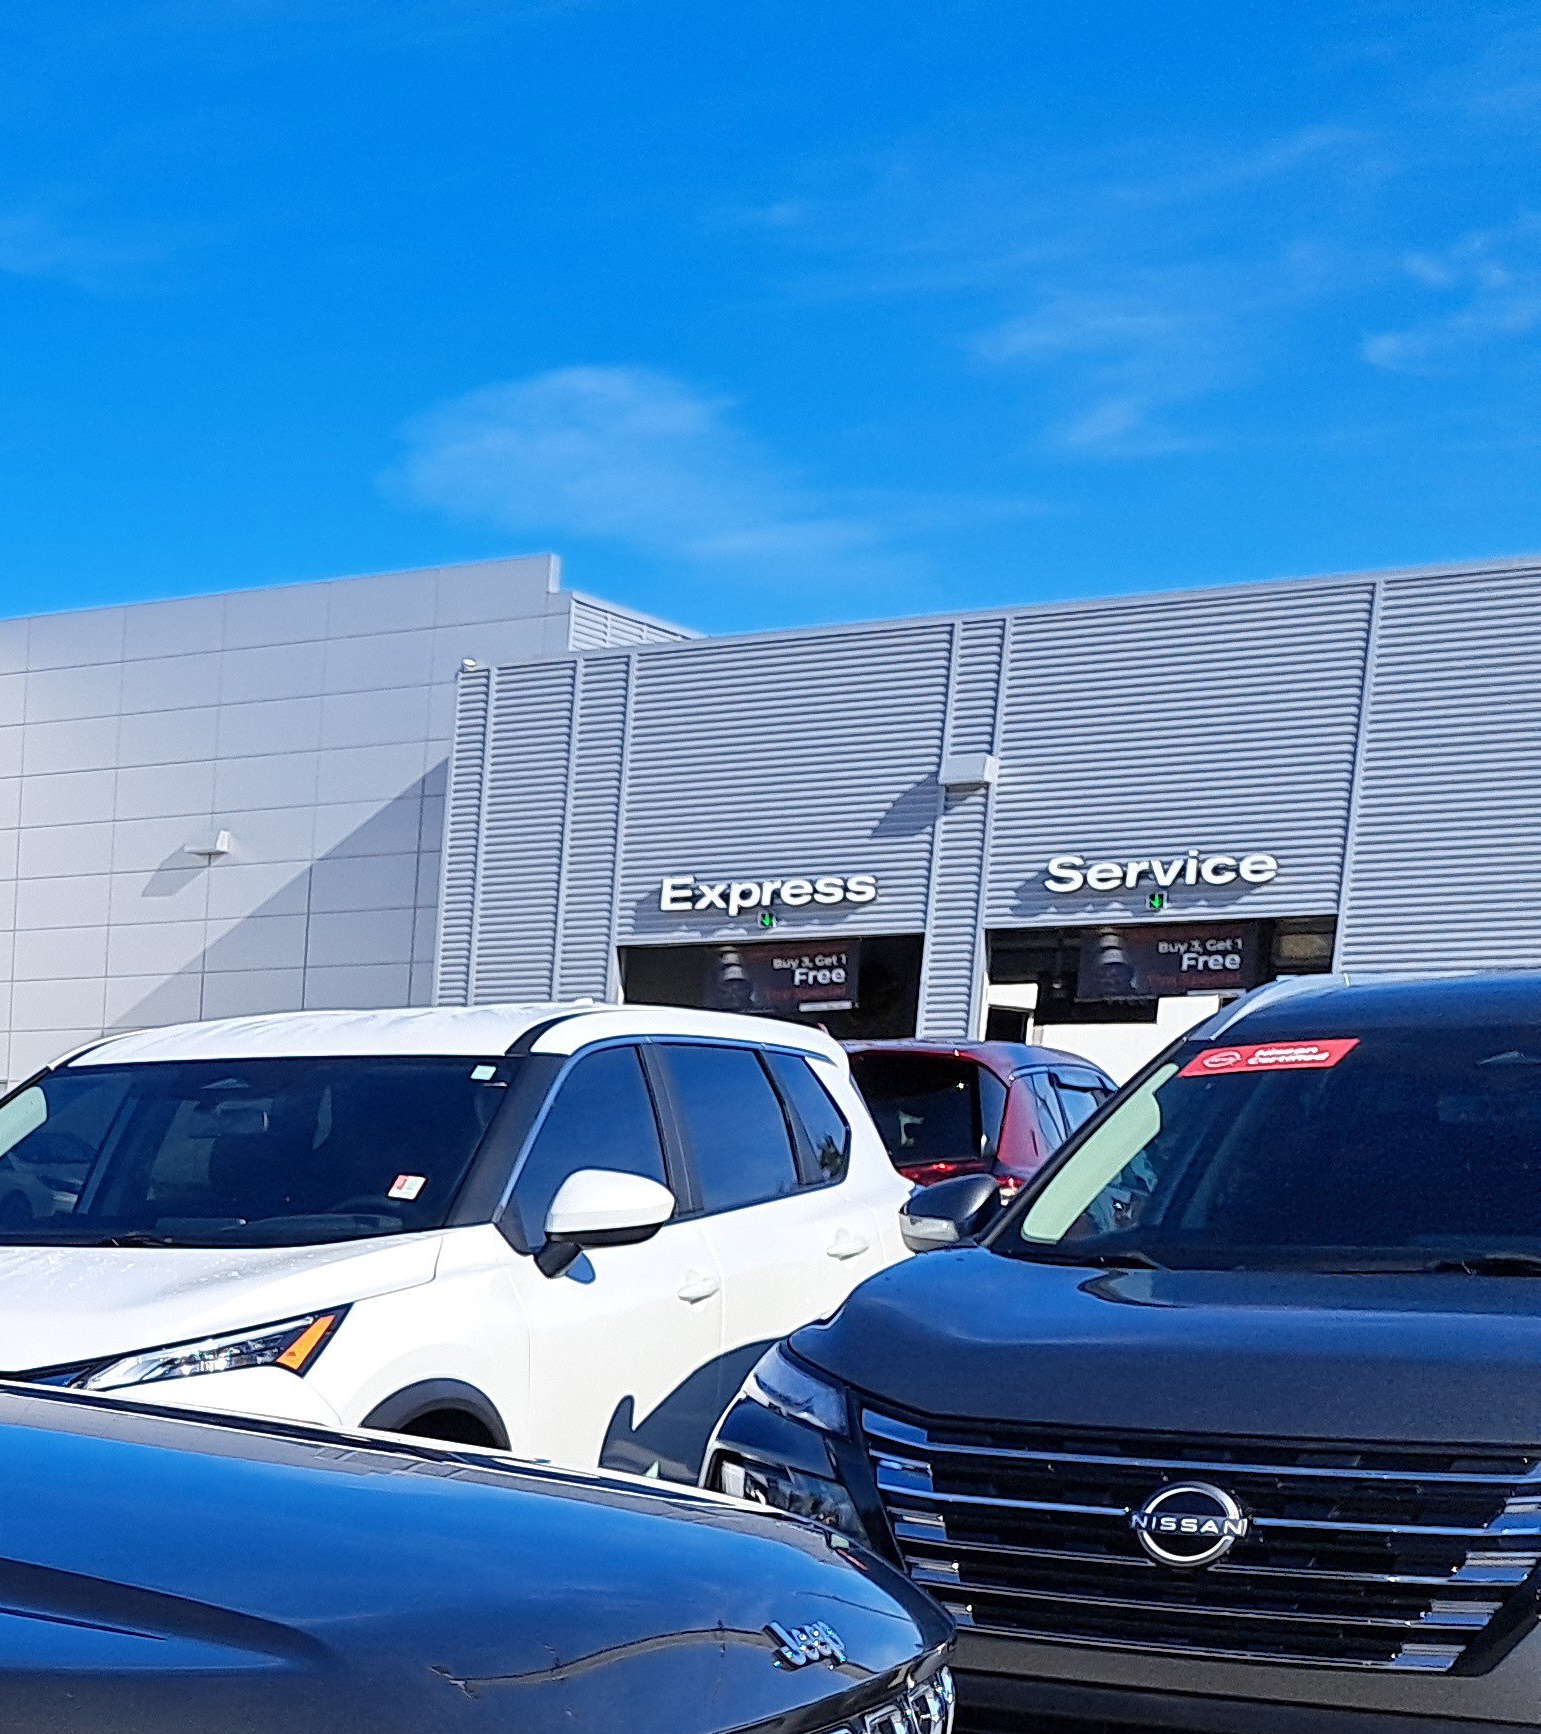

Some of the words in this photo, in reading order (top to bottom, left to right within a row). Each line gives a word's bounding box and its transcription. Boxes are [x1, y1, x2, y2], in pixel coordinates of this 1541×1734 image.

[1044, 849, 1279, 893] Service
[660, 875, 878, 917] Express
[1157, 940, 1187, 954] Buy
[1205, 938, 1232, 951] Get
[772, 957, 799, 970] Buy
[814, 954, 838, 967] Get
[1181, 952, 1241, 972] Free
[794, 968, 846, 986] Free
[1130, 1514, 1248, 1537] NISSAN
